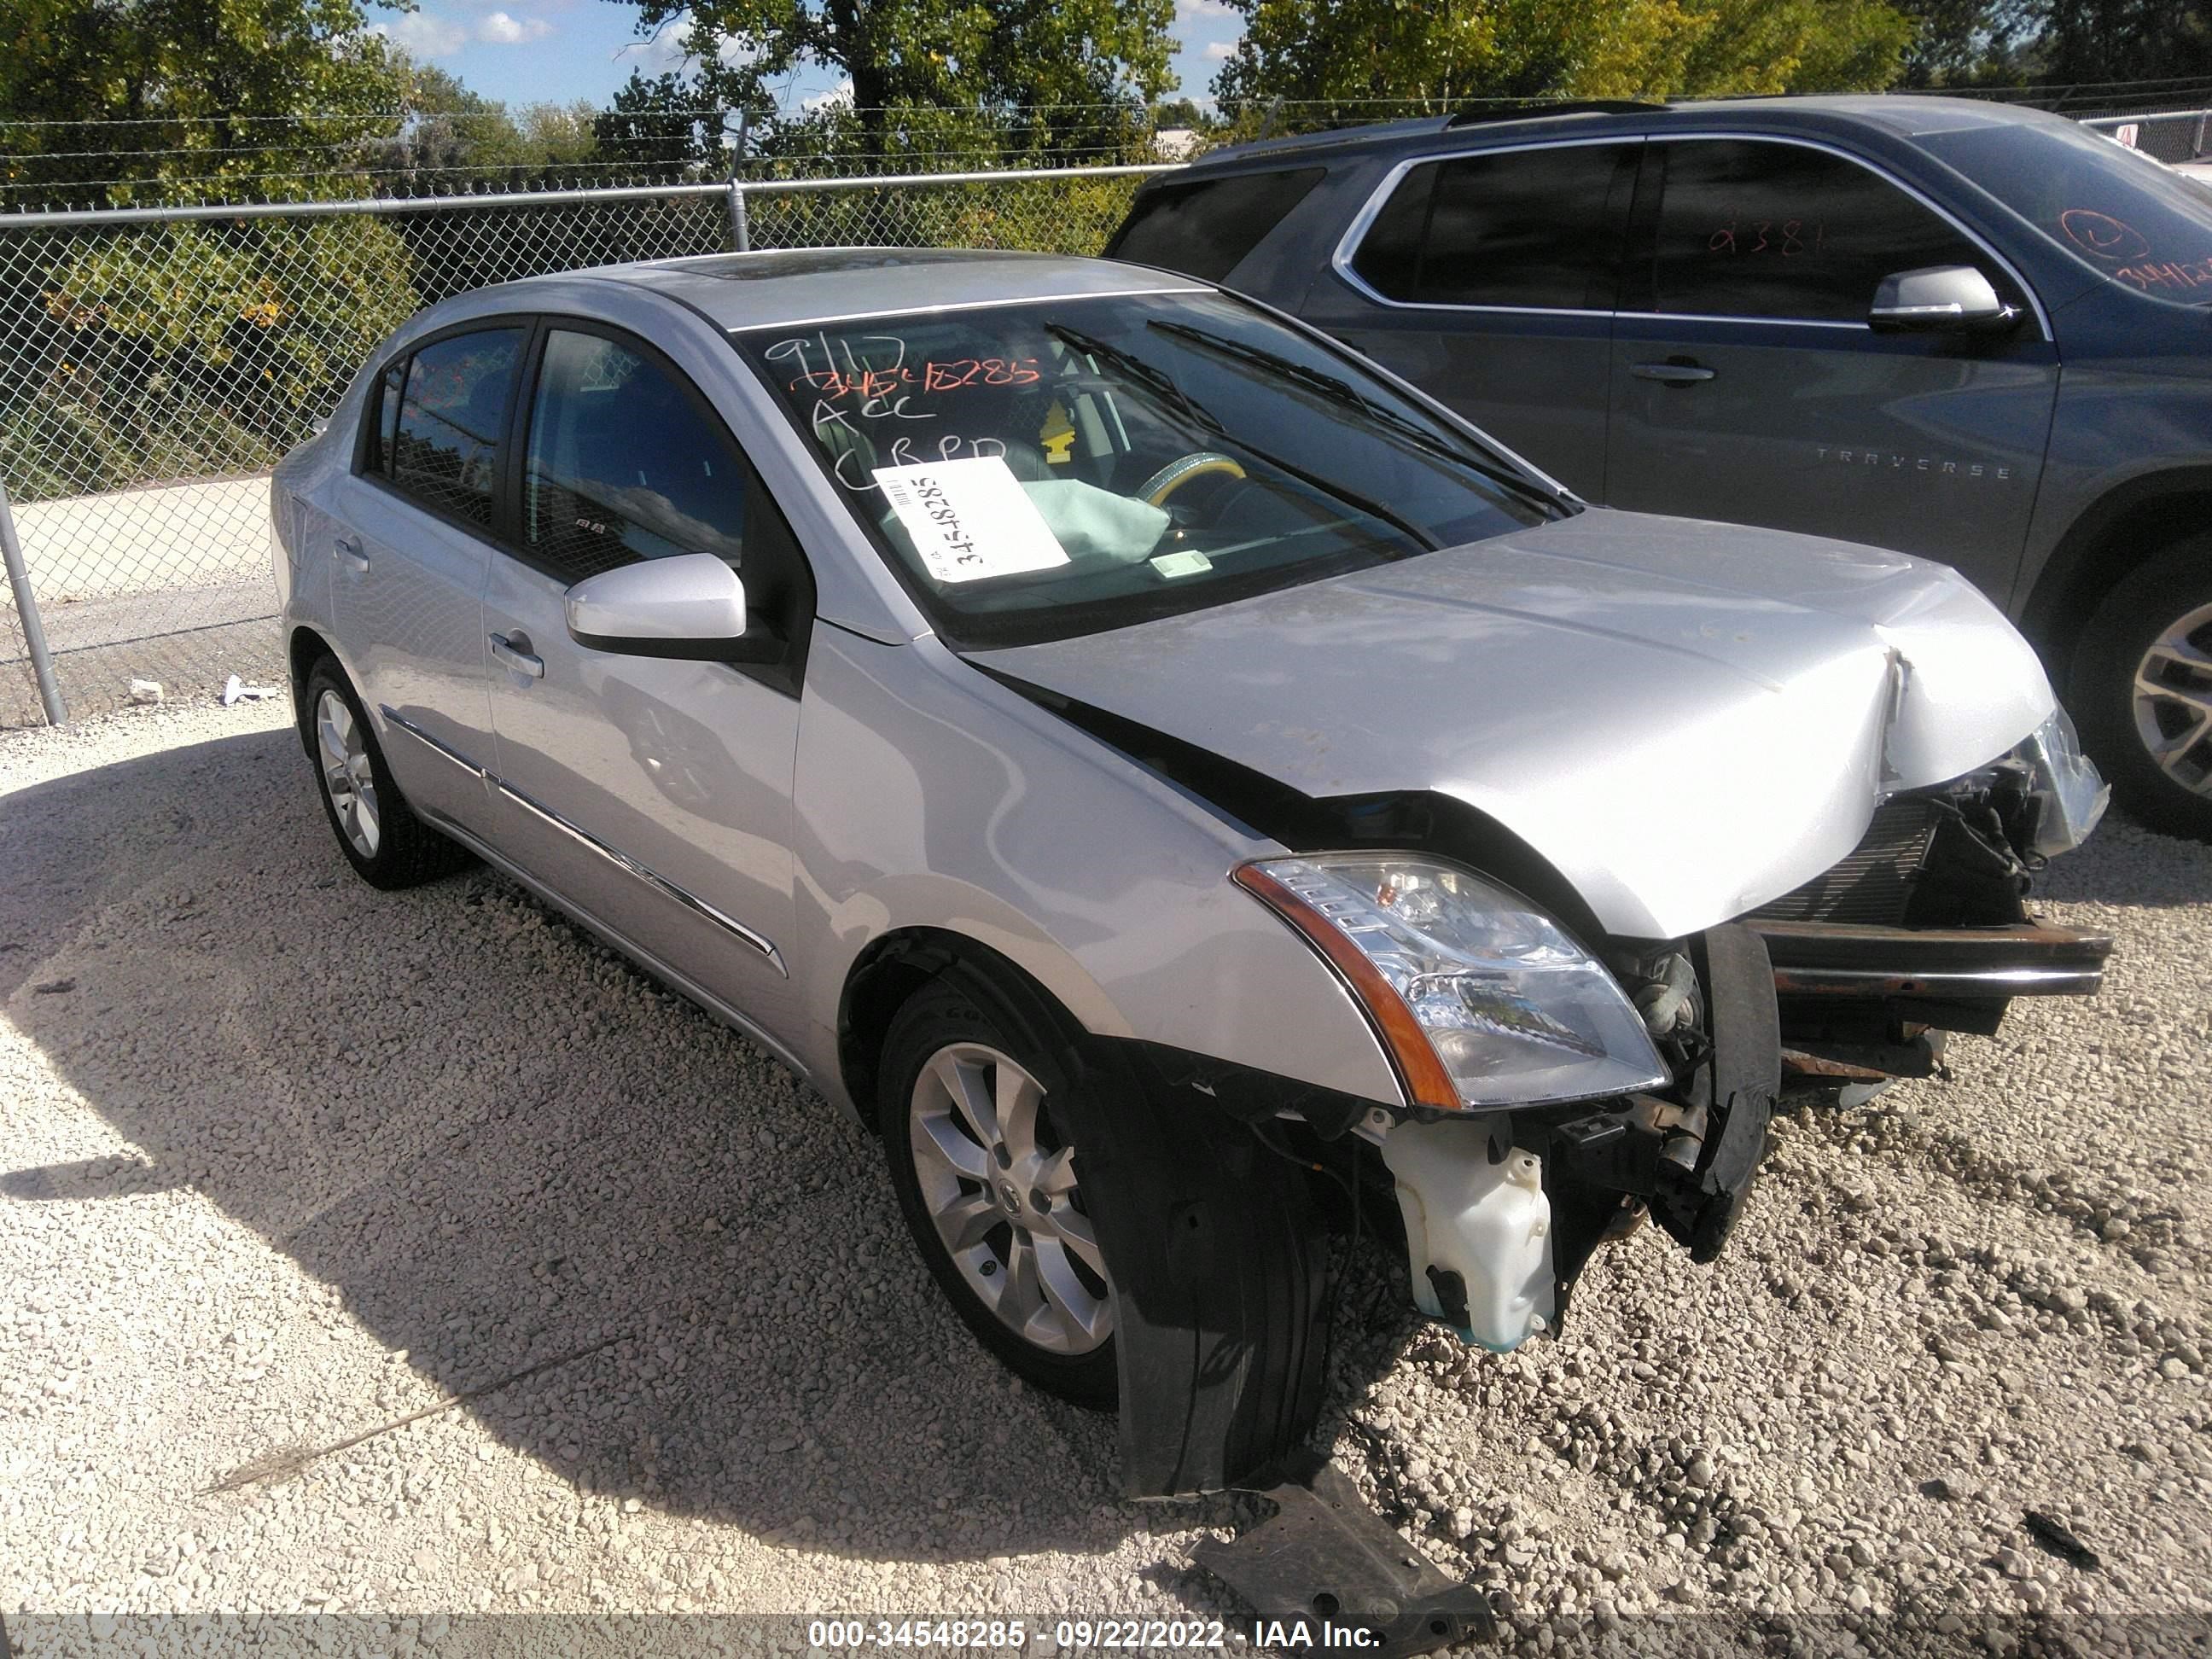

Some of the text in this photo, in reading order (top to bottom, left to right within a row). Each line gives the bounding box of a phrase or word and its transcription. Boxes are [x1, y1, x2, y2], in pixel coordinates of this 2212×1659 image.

[812, 396, 938, 442] ACC
[1817, 448, 2011, 480] TRAVERSE
[910, 477, 984, 566] 34548285
